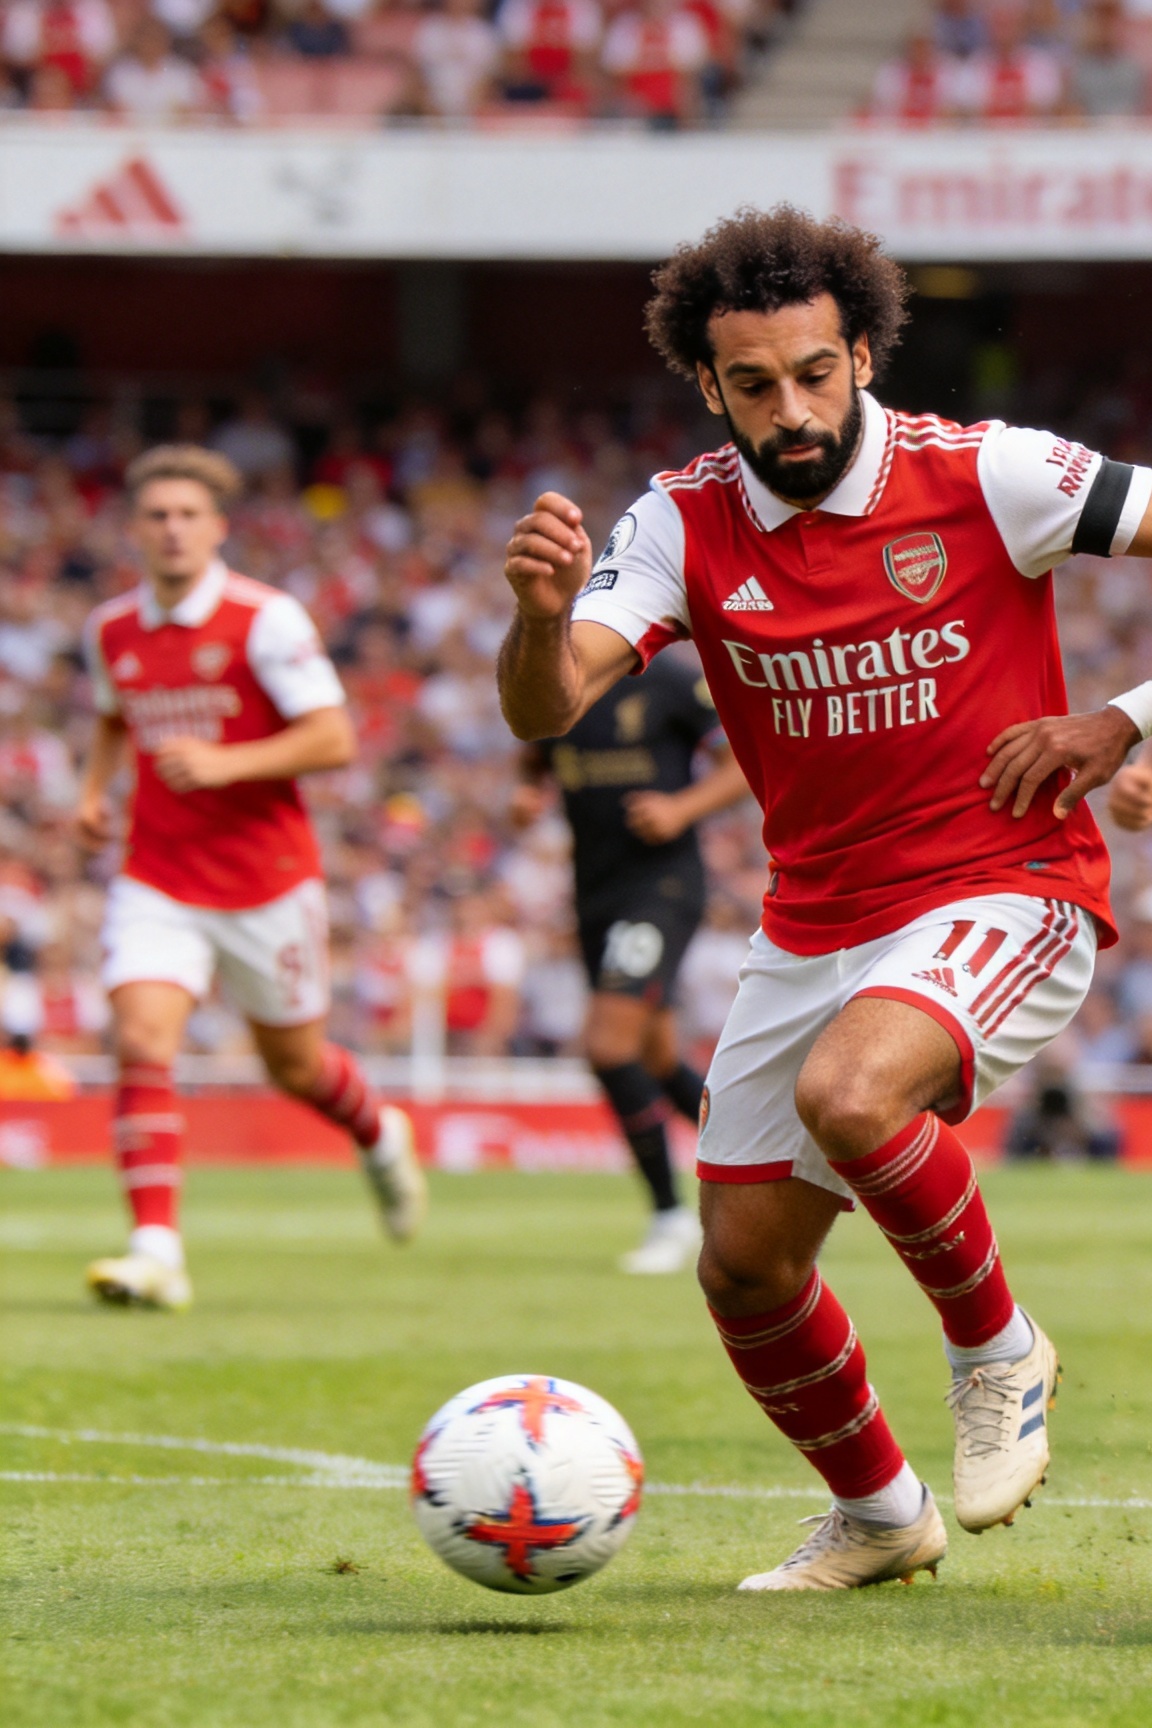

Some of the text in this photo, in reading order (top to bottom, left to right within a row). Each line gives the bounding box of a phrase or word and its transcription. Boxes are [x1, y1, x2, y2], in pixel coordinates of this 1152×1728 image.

[721, 619, 971, 691] Emirates
[771, 677, 941, 738] FLY BETTER
[932, 919, 1009, 979] 11
